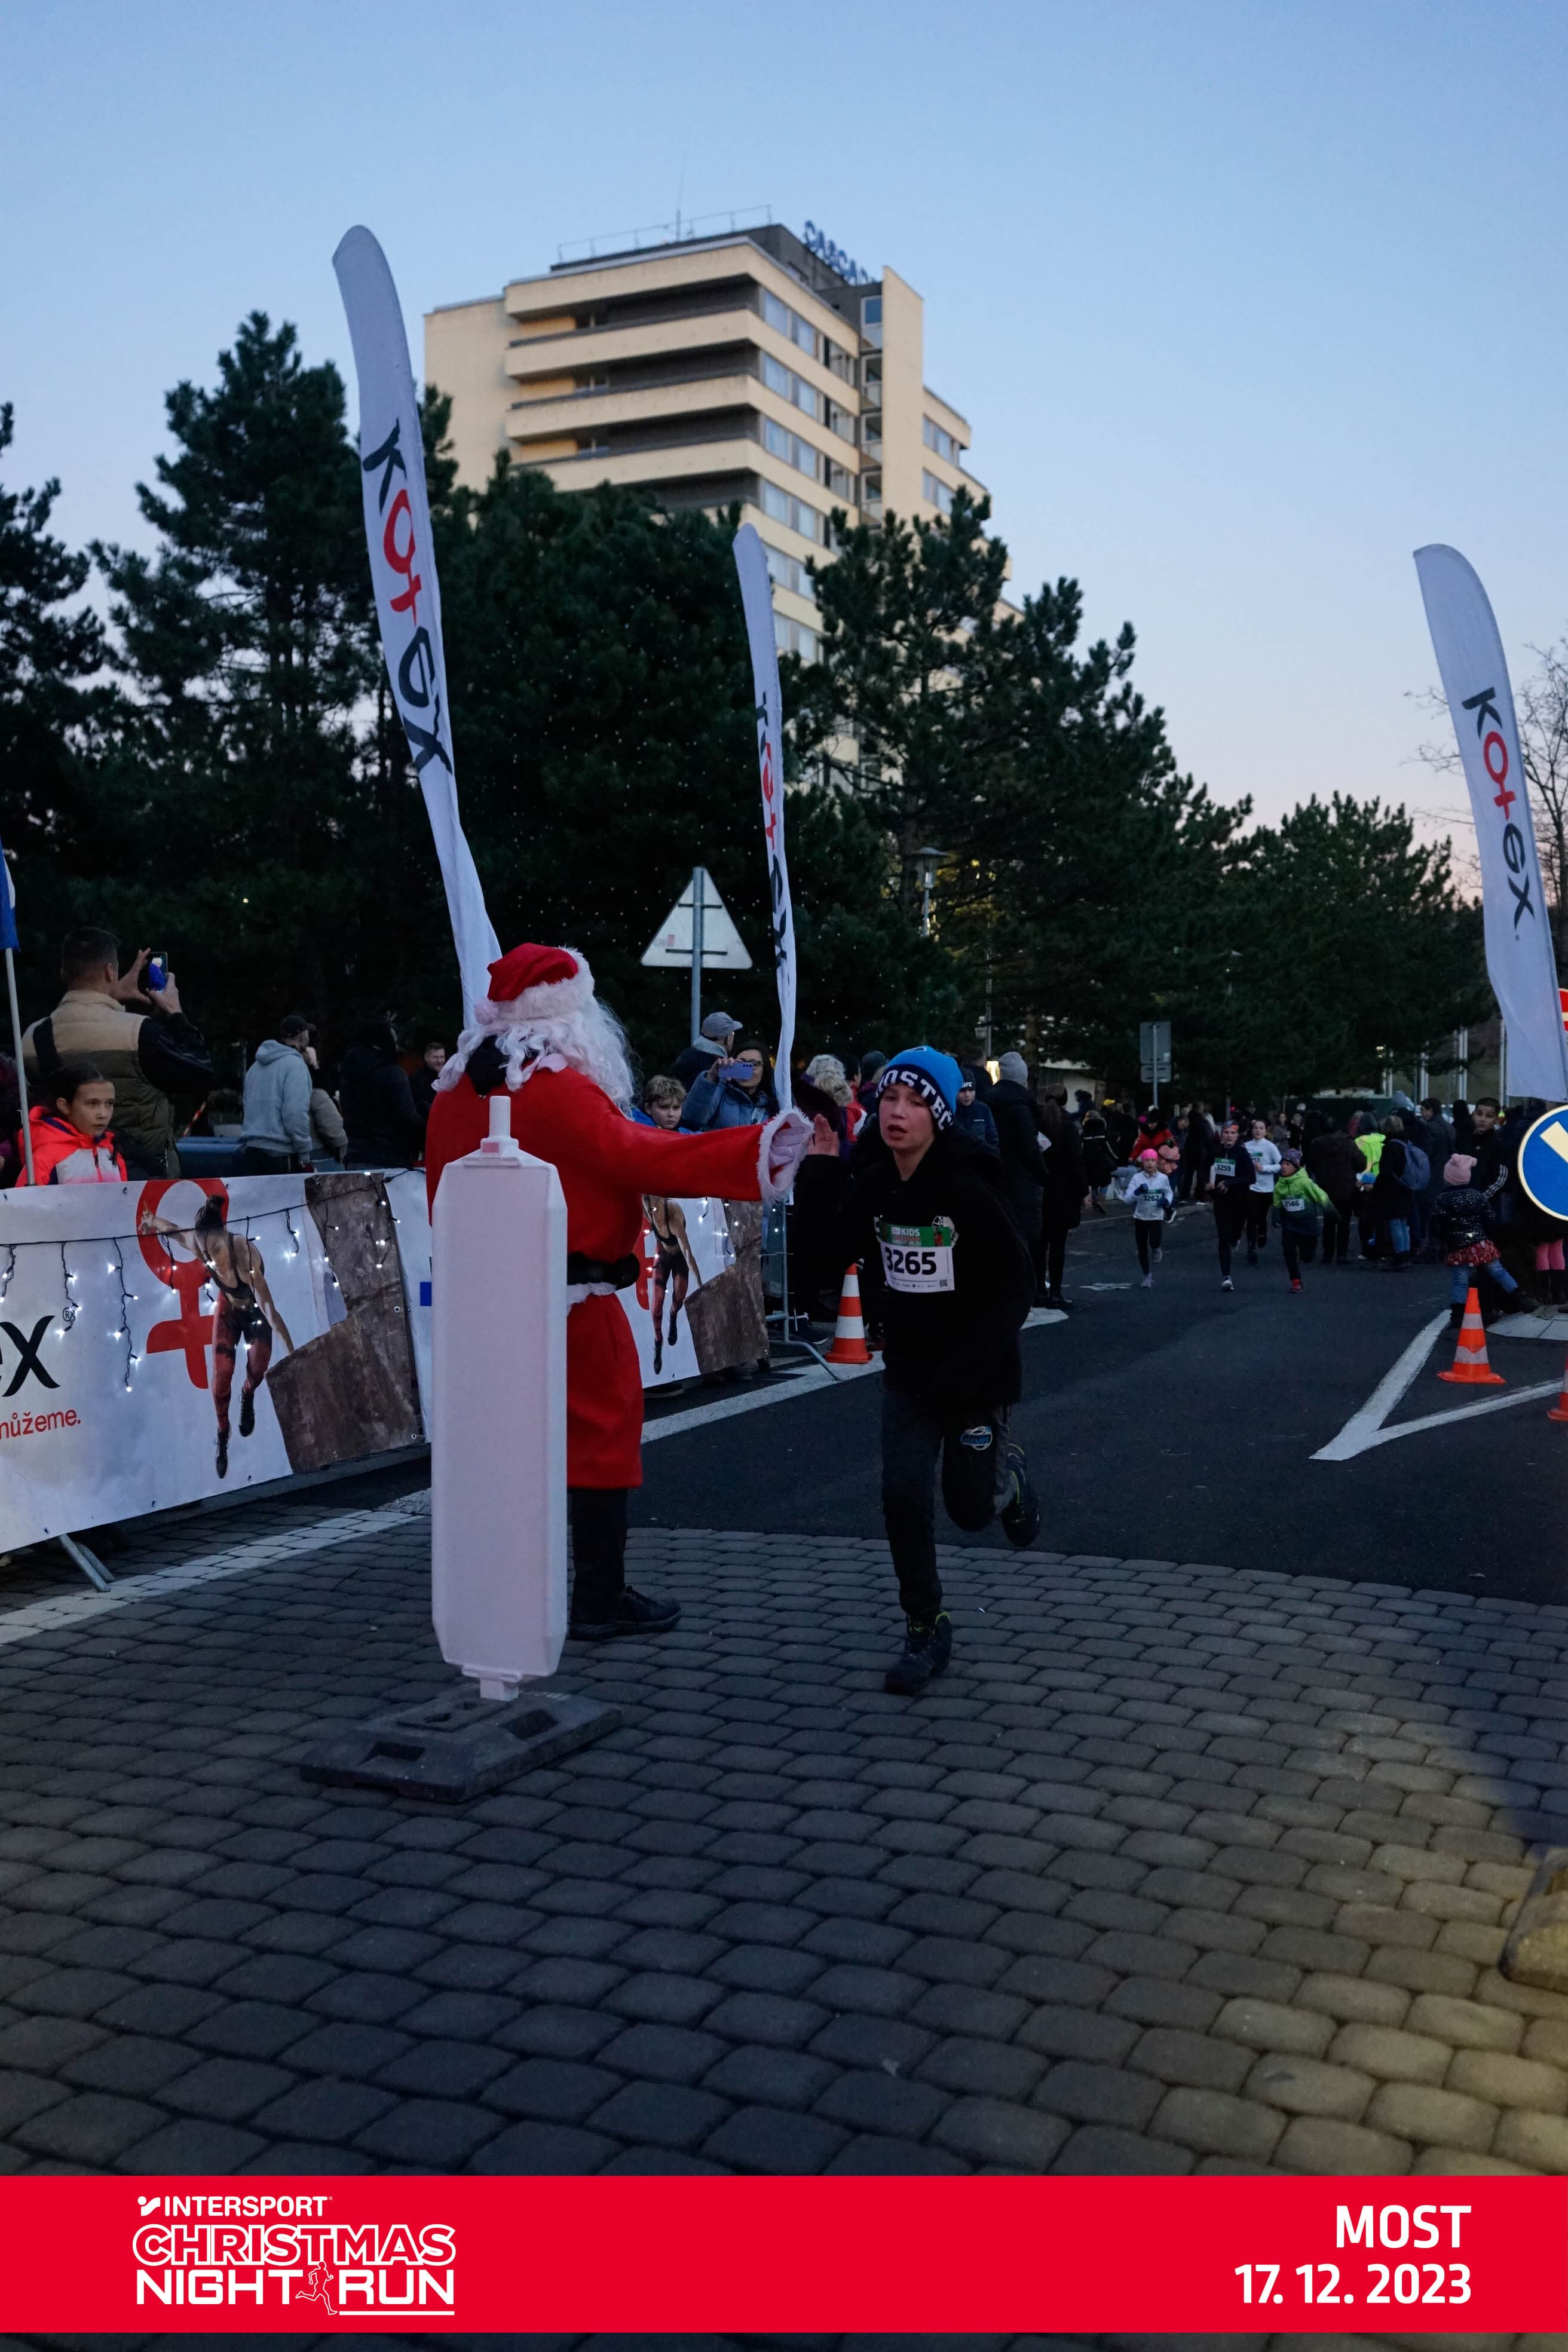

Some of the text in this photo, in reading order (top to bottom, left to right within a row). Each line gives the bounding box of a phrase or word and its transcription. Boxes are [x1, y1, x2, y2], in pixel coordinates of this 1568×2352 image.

[362, 416, 453, 777] Kotex
[1462, 687, 1535, 930] Kotex
[885, 1247, 937, 1275] 3265
[901, 1228, 921, 1237] KIDS
